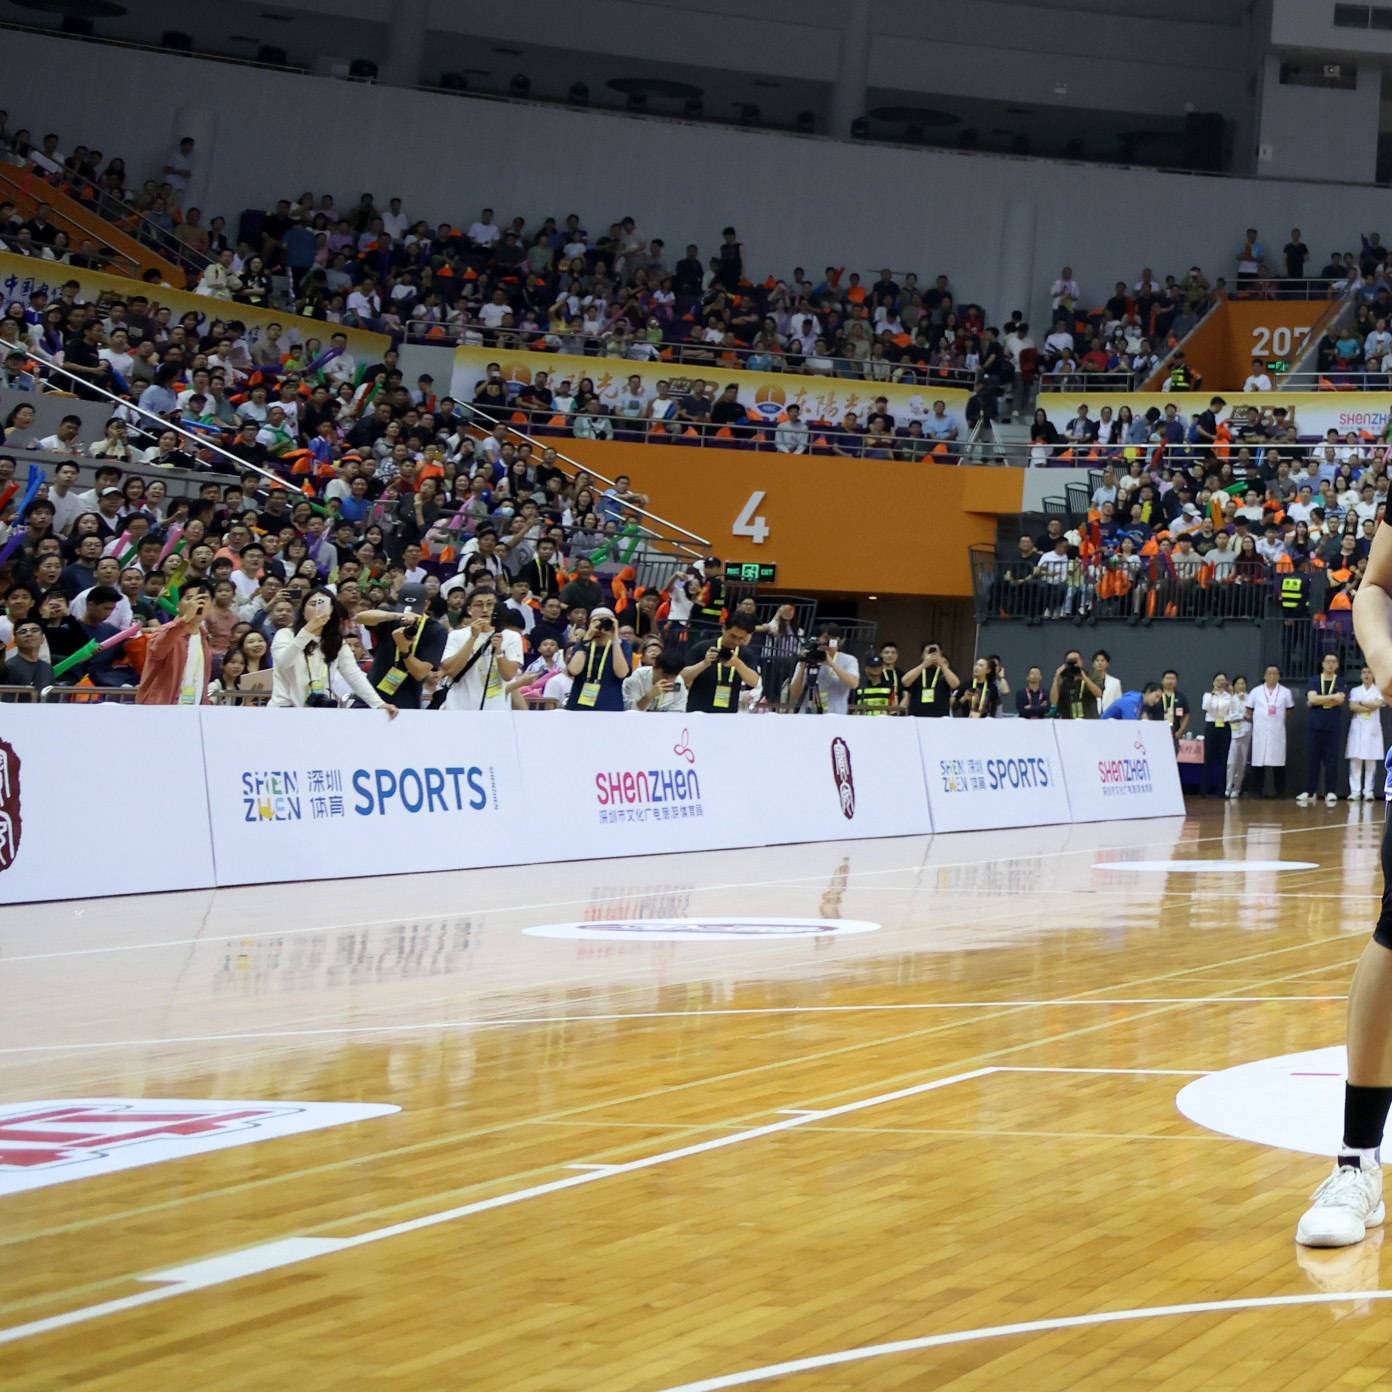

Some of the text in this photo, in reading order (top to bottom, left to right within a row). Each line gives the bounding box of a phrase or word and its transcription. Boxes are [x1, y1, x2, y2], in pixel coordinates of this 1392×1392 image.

[1251, 326, 1312, 357] 207
[732, 491, 769, 544] 4
[242, 769, 343, 796] SHEN 深圳
[987, 758, 1048, 791] SPORTS
[352, 766, 487, 816] SPORTS
[310, 795, 345, 820] 体育
